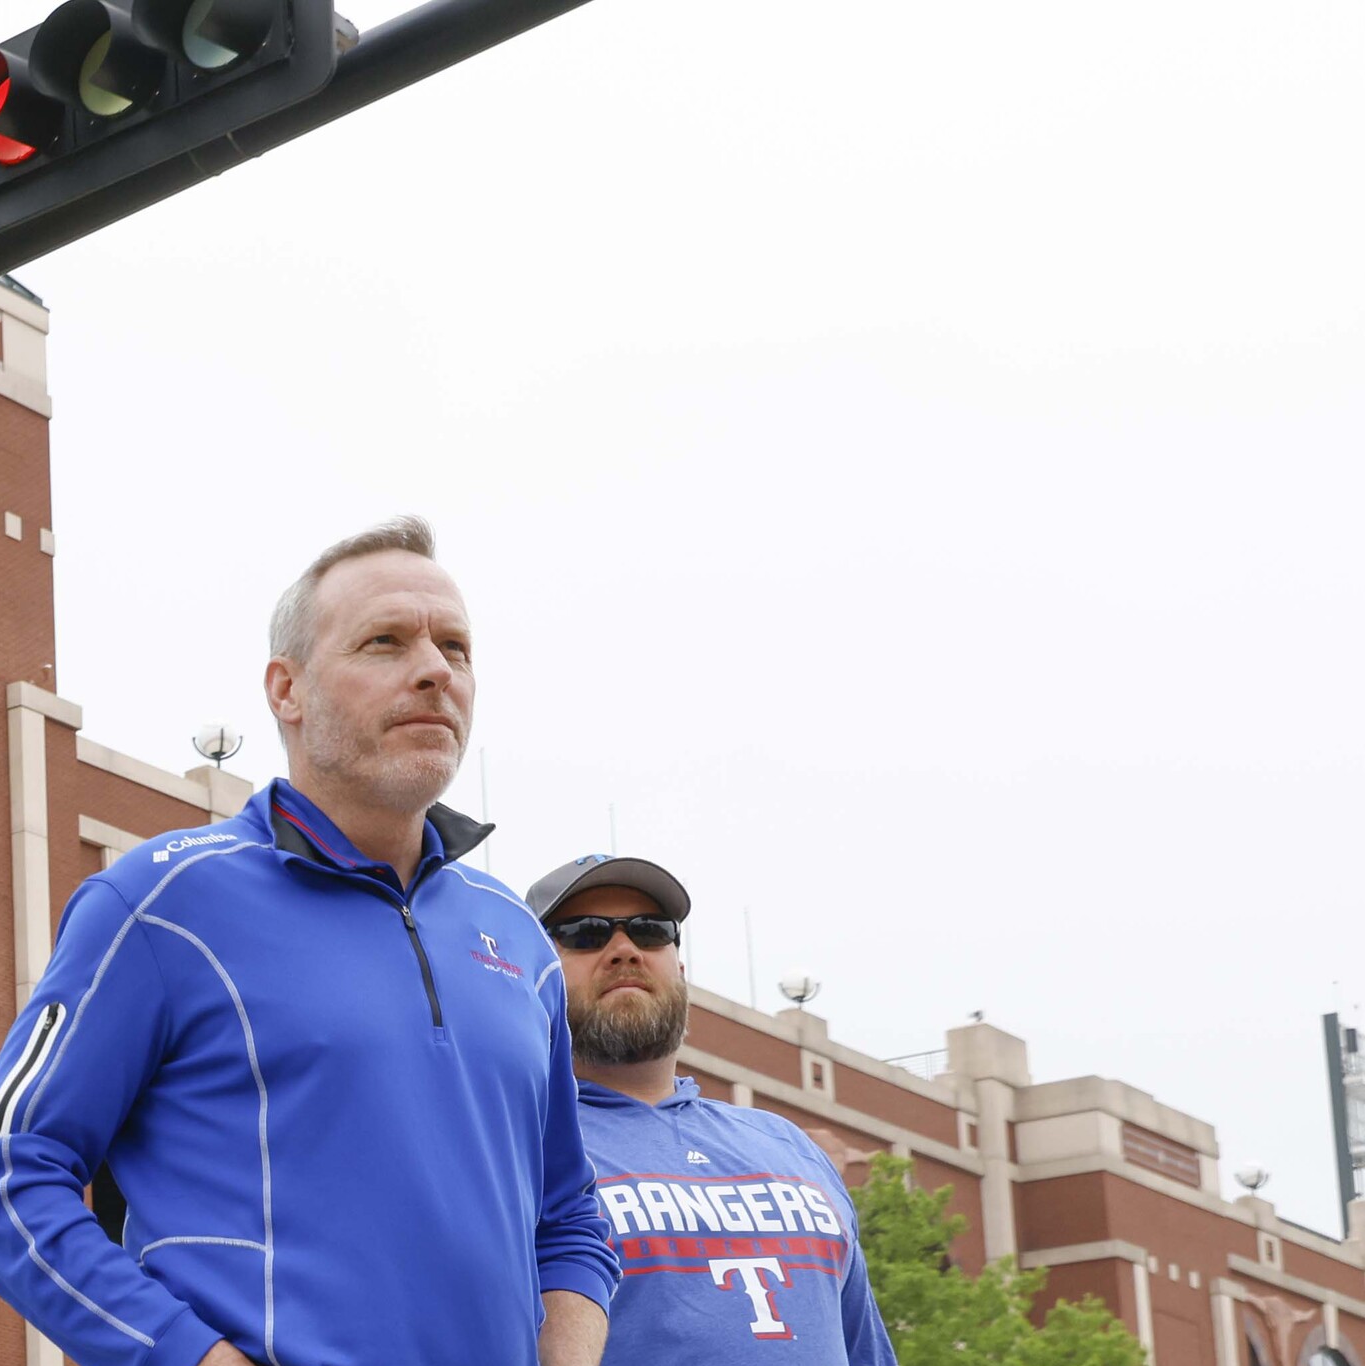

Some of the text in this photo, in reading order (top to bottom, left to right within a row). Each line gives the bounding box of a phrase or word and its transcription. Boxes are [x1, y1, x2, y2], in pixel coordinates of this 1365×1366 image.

[166, 833, 238, 852] Columbia
[598, 1182, 842, 1236] RANGERS
[707, 1257, 794, 1340] T
